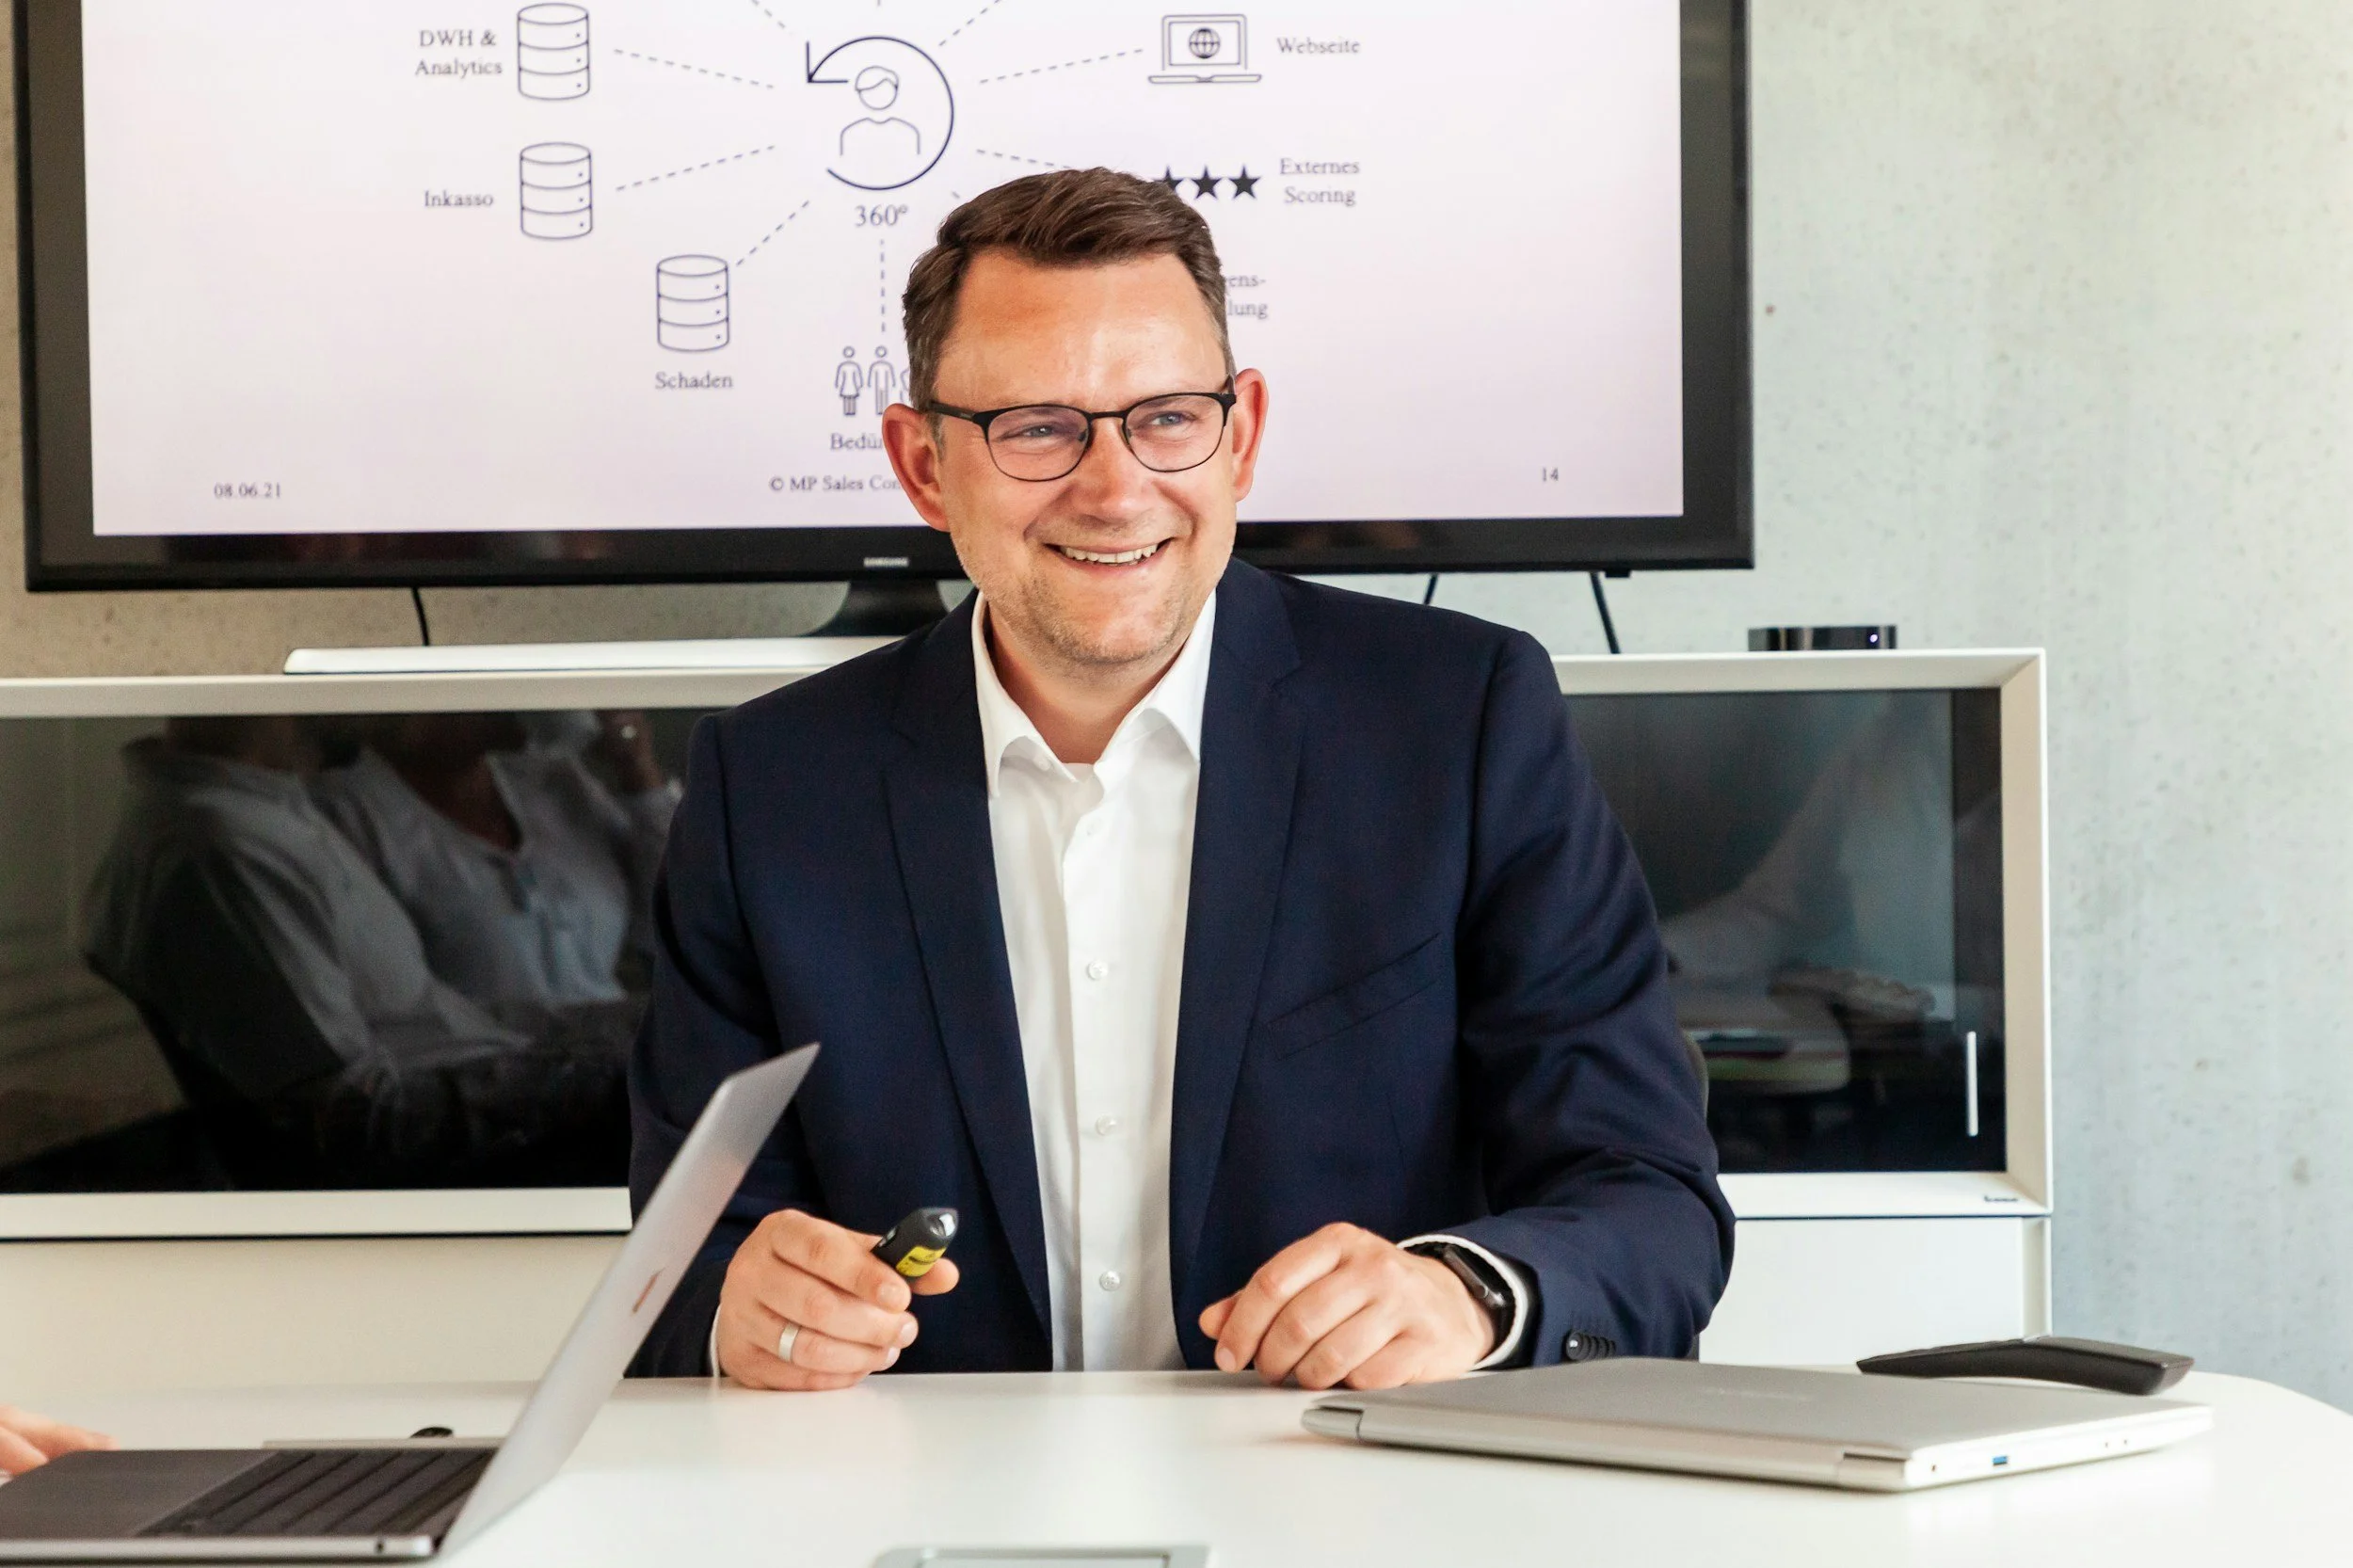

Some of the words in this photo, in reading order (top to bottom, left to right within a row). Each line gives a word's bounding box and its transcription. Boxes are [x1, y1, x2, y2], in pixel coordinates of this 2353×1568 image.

[419, 29, 473, 47] DWH
[480, 29, 497, 46] &
[1276, 37, 1361, 55] Webseite
[414, 57, 504, 79] Analytics
[1279, 157, 1361, 175] Externes
[424, 189, 494, 207] Inkasso
[1284, 185, 1357, 208] Scoring
[1226, 275, 1267, 288] ens-
[653, 371, 734, 390] Schaden
[790, 475, 818, 490] MP
[823, 474, 864, 491] Sales
[1542, 467, 1560, 483] 14
[213, 482, 281, 500] 08.06.21
